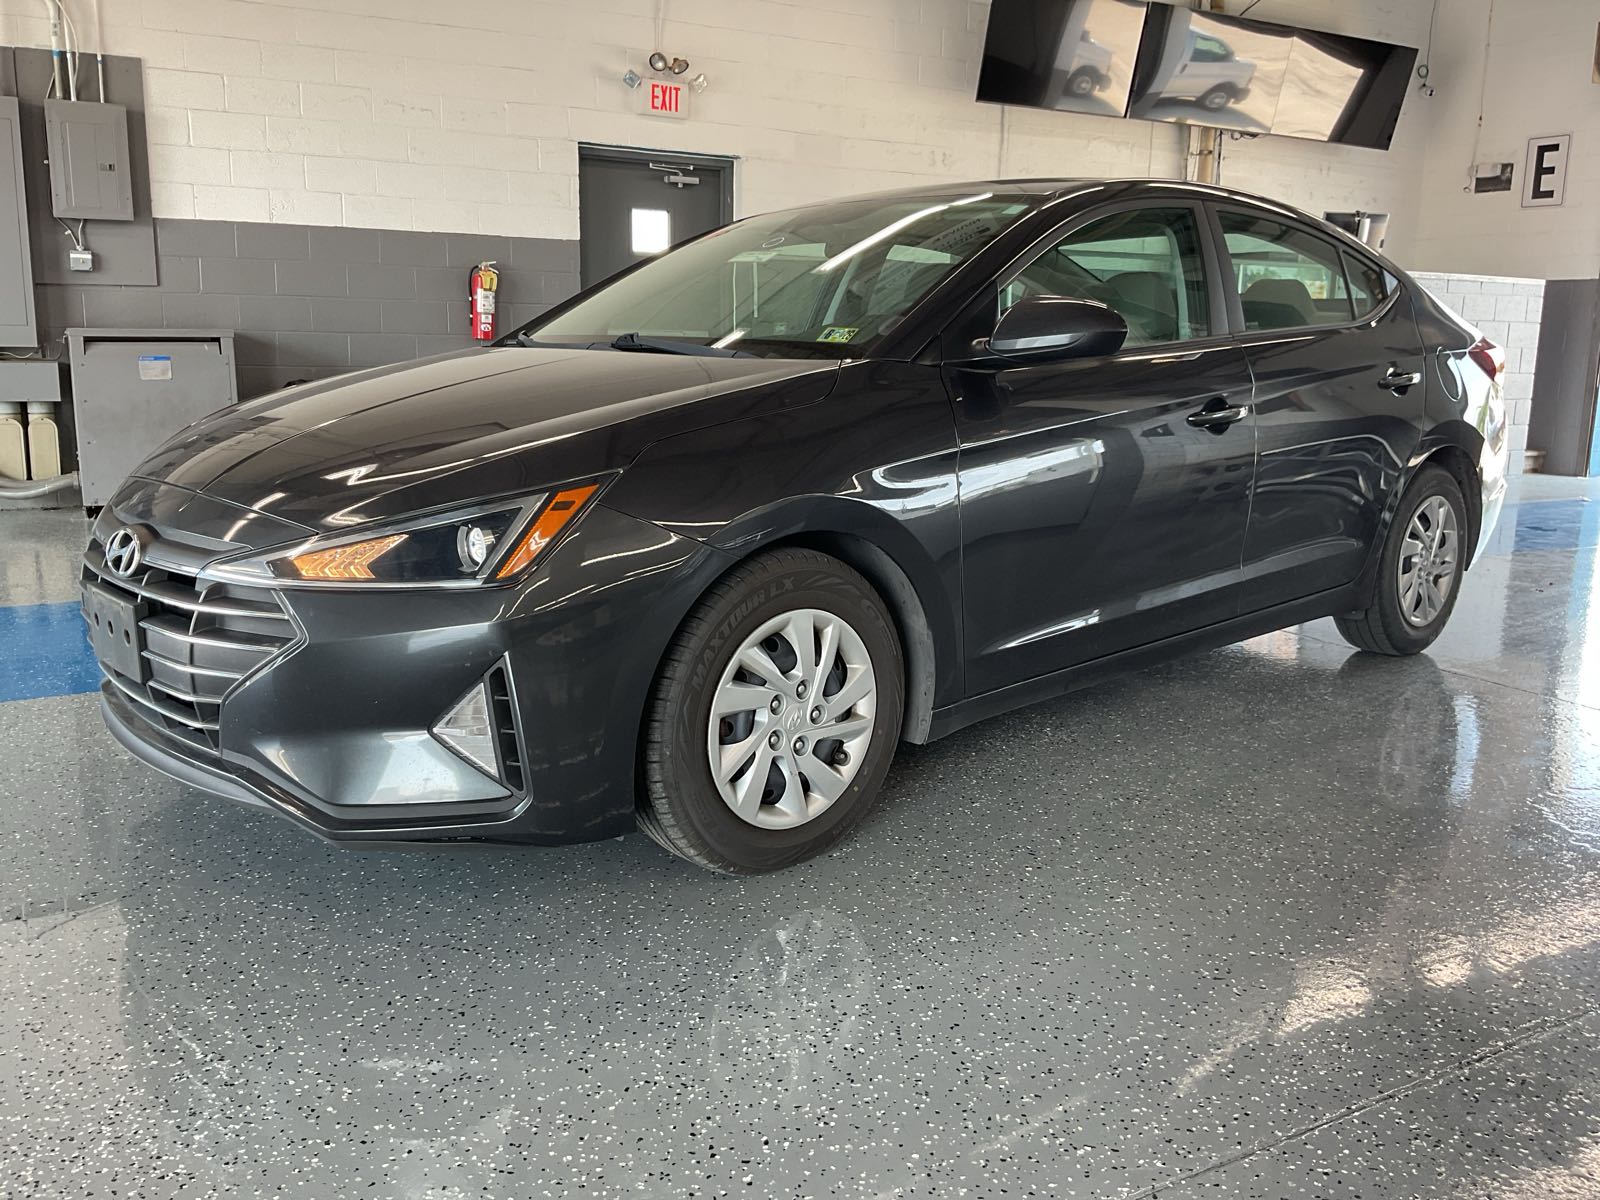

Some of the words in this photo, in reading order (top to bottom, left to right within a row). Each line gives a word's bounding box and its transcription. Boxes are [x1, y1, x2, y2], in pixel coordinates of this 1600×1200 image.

[651, 83, 681, 113] EXIT
[1531, 143, 1560, 200] E
[691, 589, 766, 690] MAXTOUR
[769, 576, 796, 598] LX
